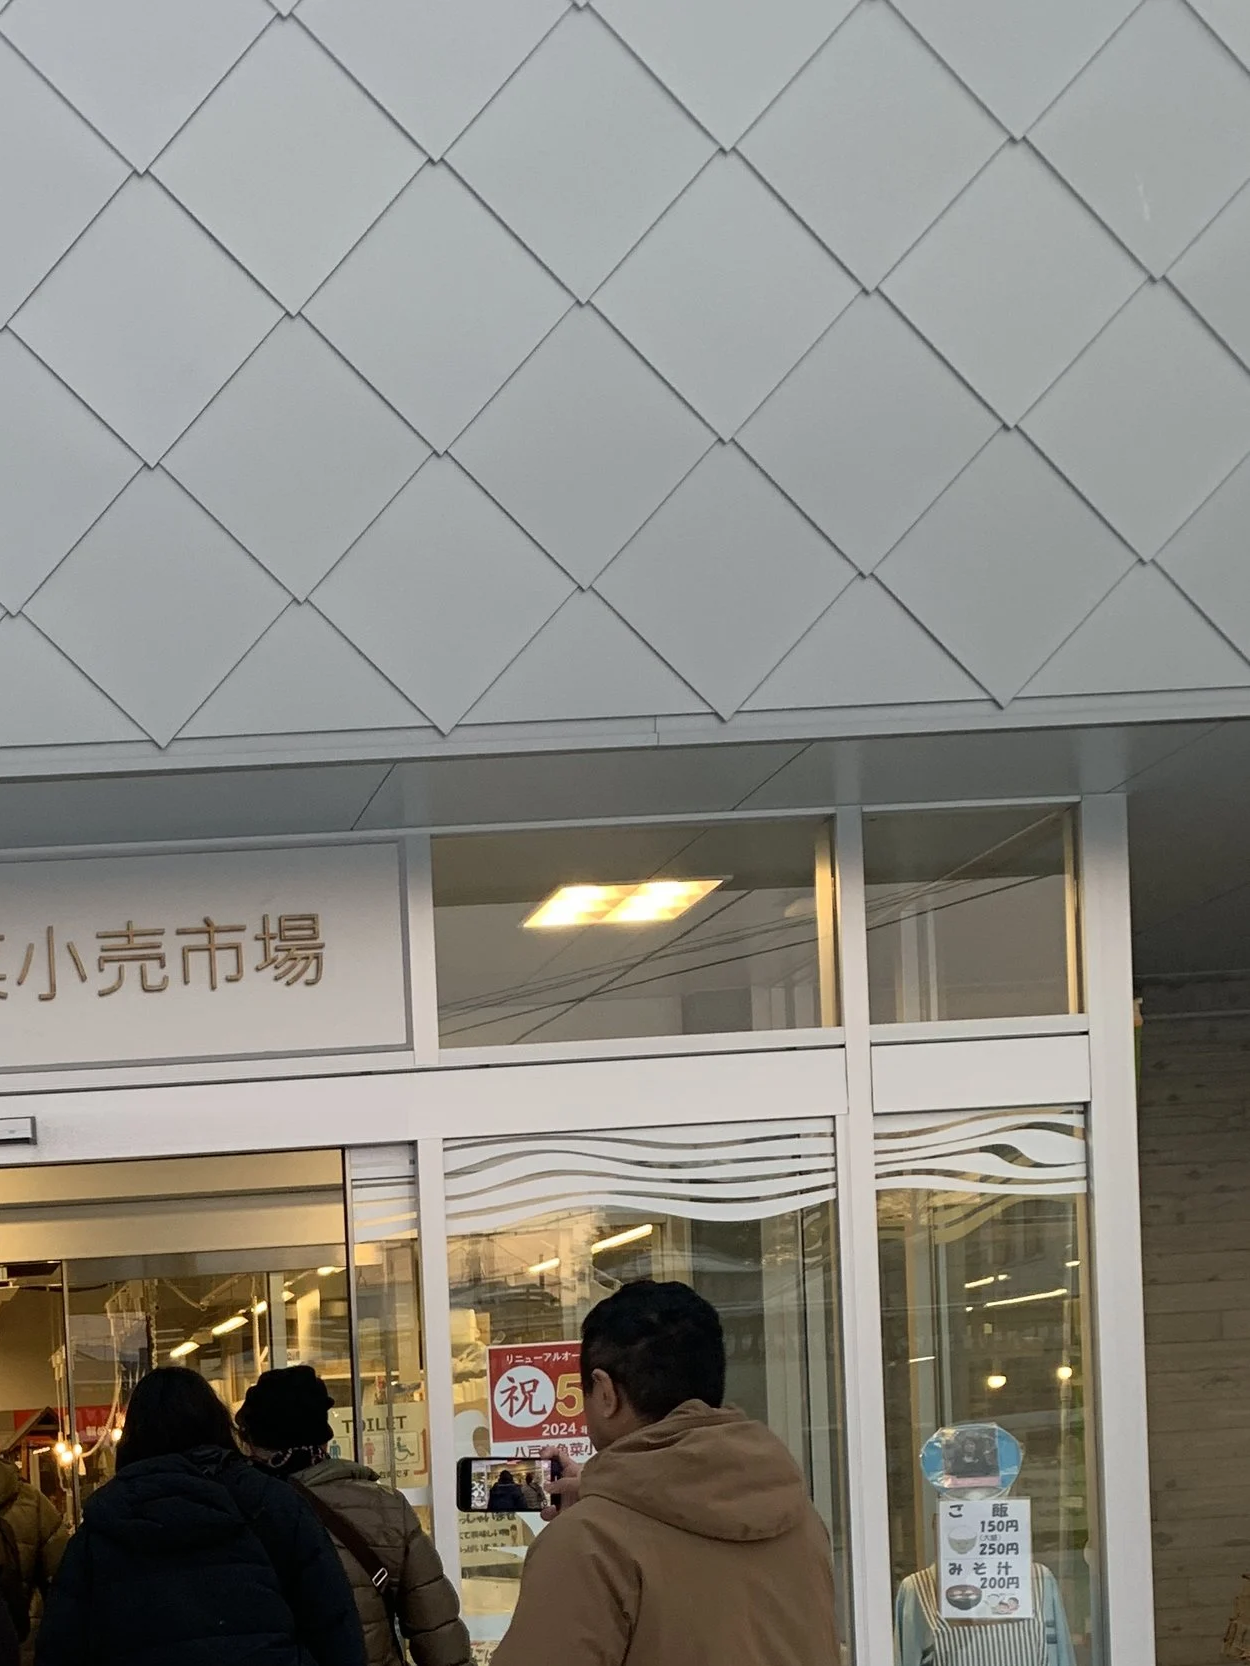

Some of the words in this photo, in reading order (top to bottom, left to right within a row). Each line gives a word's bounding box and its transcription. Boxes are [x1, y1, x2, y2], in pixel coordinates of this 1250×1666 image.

[500, 1376, 547, 1418] 祝
[980, 1520, 1019, 1533] 150円
[979, 1543, 1019, 1556] 250円
[980, 1576, 1020, 1589] 200円
